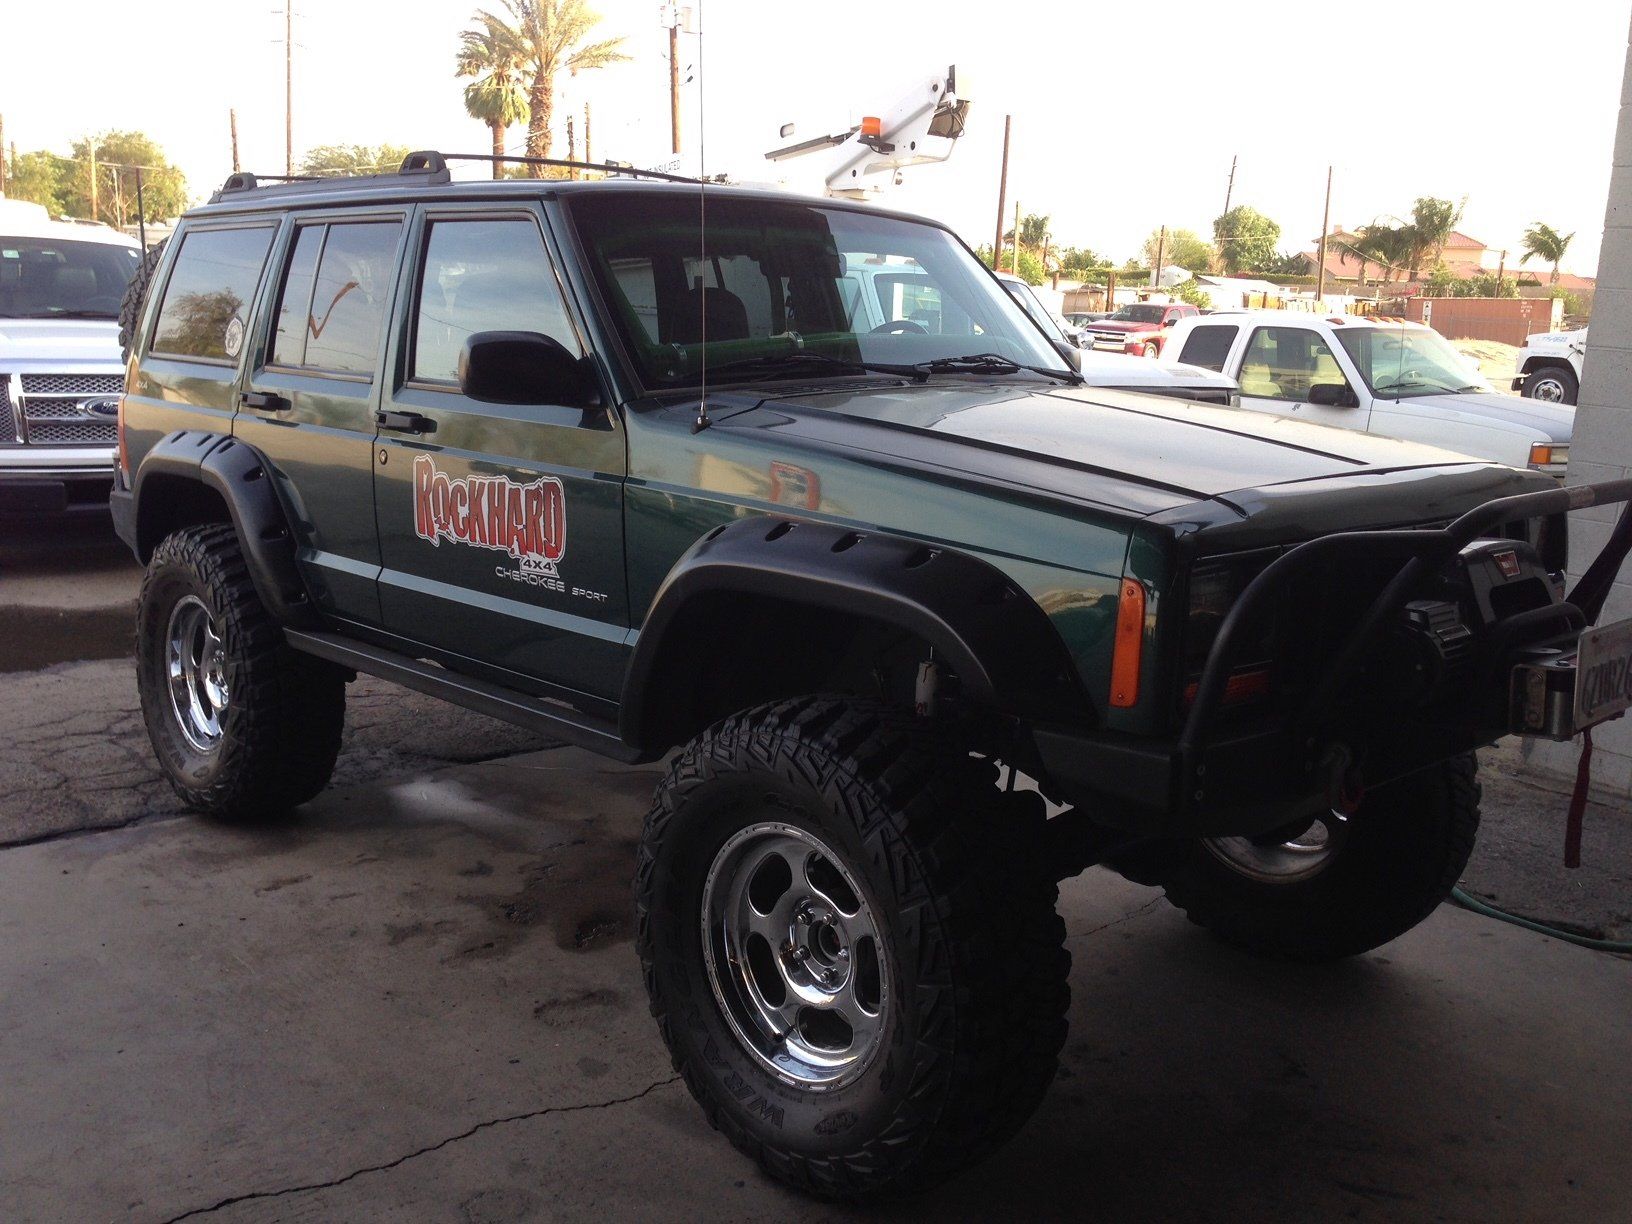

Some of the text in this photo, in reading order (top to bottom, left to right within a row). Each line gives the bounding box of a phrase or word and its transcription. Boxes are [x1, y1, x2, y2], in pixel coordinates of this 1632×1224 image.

[414, 457, 564, 560] ROCKHARD
[522, 558, 554, 572] 4X4
[494, 566, 608, 603] CHEROKEE SPORT
